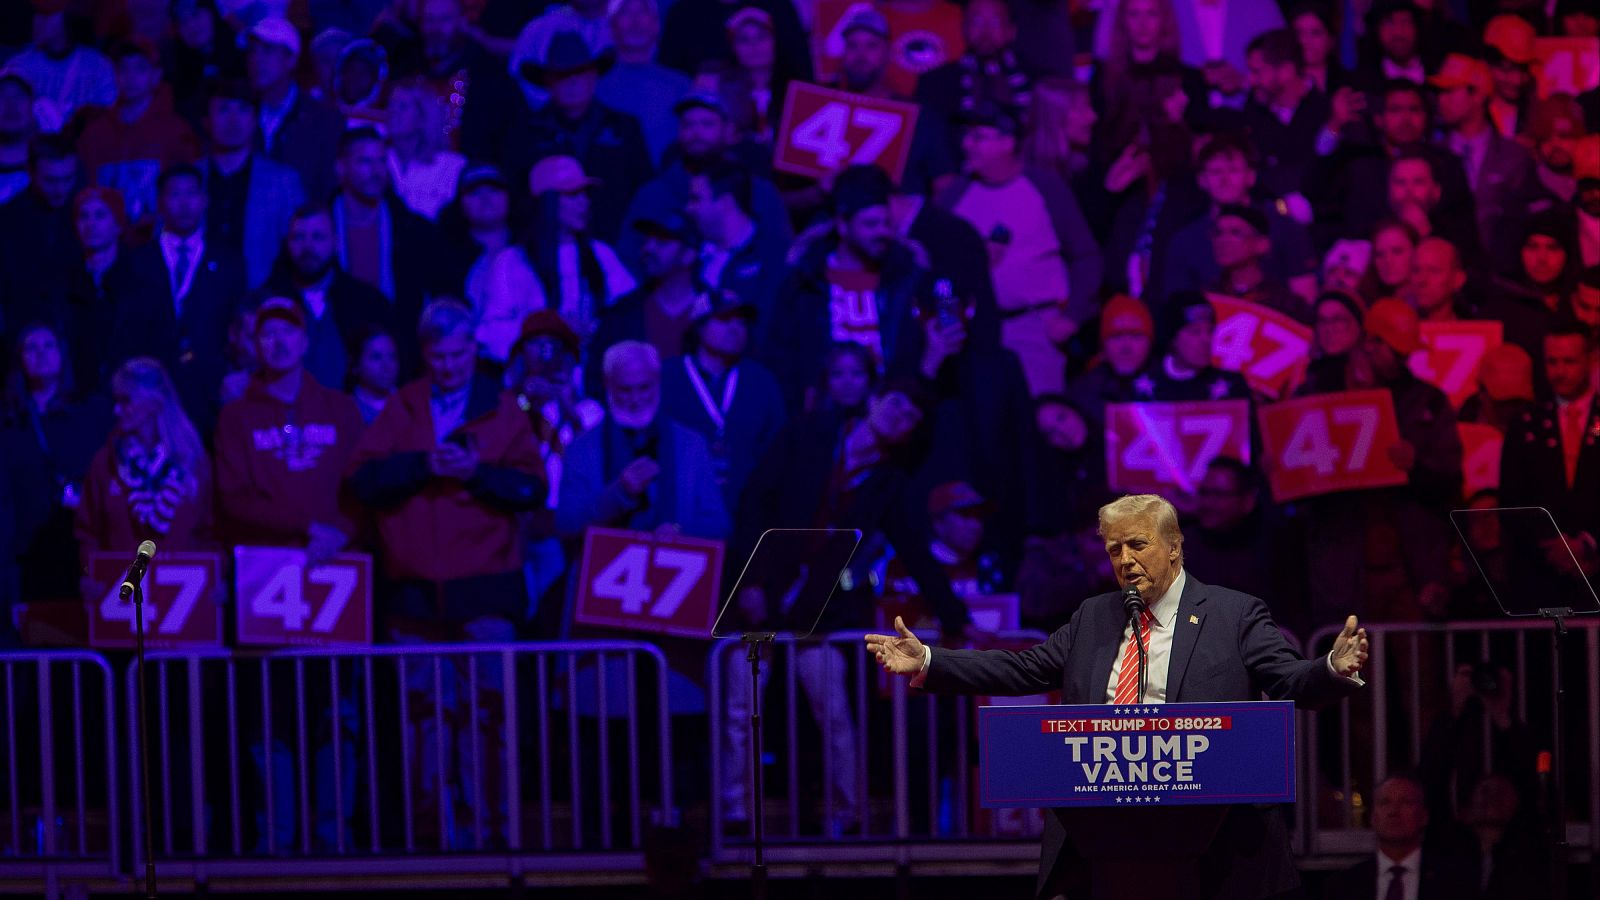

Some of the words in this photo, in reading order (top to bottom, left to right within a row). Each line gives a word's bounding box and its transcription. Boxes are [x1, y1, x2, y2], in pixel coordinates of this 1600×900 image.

[791, 102, 903, 168] 47
[1211, 312, 1309, 378] 47
[1122, 416, 1232, 482] 47
[1282, 409, 1379, 475] 47
[100, 566, 207, 634] 47
[252, 563, 358, 633] 47
[592, 543, 708, 619] 47
[1048, 720, 1087, 732] TEXT
[1091, 719, 1146, 732] TRUMP
[1149, 718, 1170, 730] TO
[1174, 717, 1222, 730] 88022
[1064, 735, 1210, 762] TRUMP
[1081, 761, 1194, 783] VANCE
[1100, 784, 1139, 792] AMERICA
[1171, 783, 1202, 791] AGAIN!
